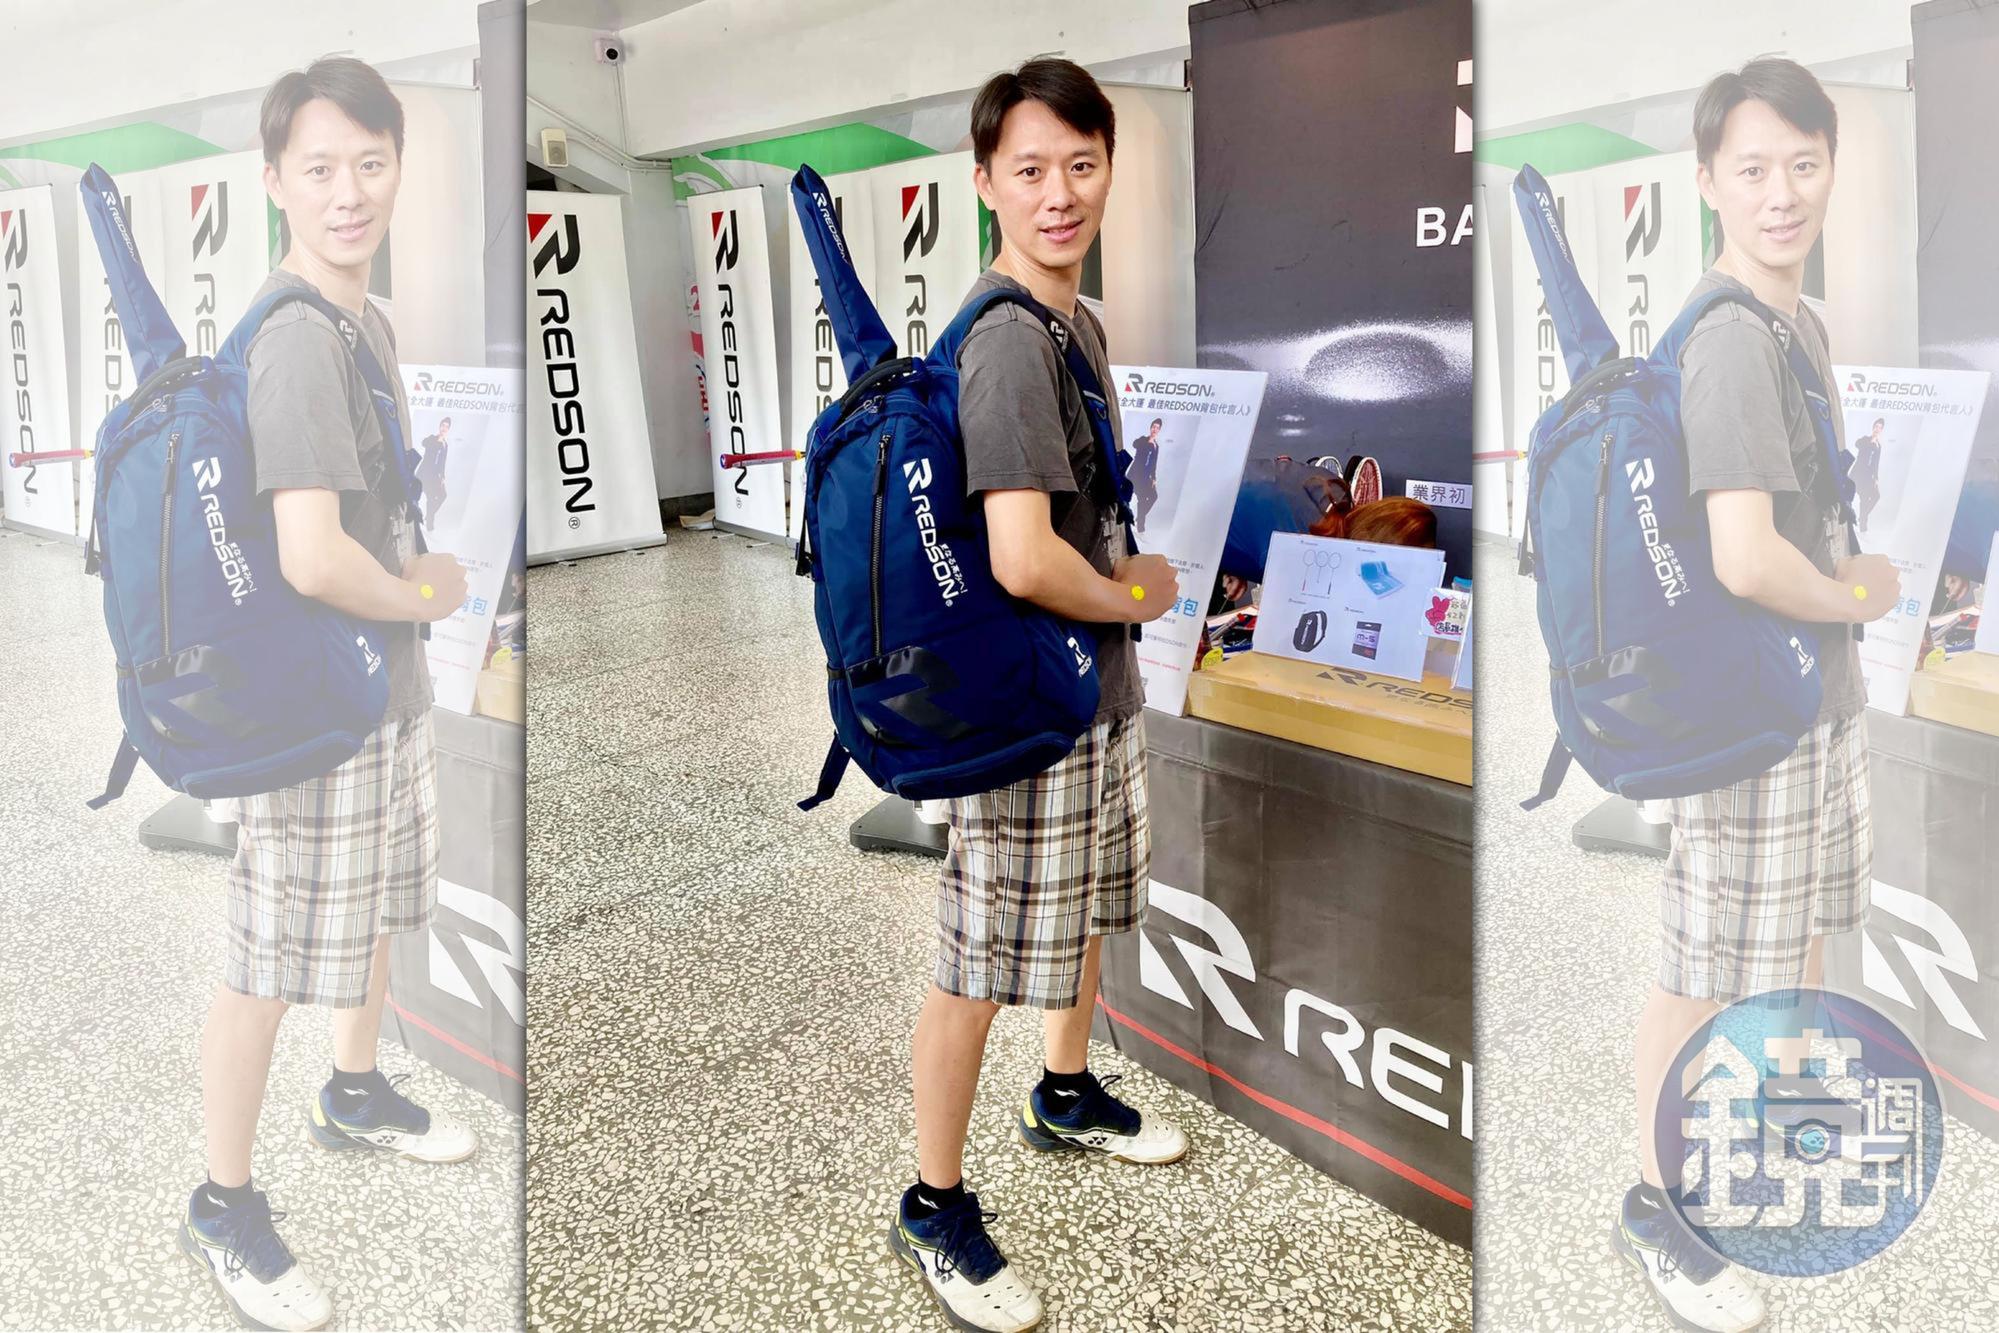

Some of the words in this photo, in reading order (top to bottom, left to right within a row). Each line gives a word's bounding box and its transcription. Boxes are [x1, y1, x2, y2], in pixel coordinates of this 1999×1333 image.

[6, 283, 38, 496] REDSON
[433, 381, 501, 396] REDSON
[537, 288, 595, 513] REDSON
[717, 284, 749, 497] REDSON
[1144, 382, 1212, 397] REDSON
[1866, 382, 1934, 397] REDSON
[201, 494, 248, 599] REDSON
[1412, 484, 1465, 504] 業界初
[912, 495, 959, 600] REDSON
[1634, 495, 1681, 600] REDSON
[1284, 988, 1473, 1143] RE
